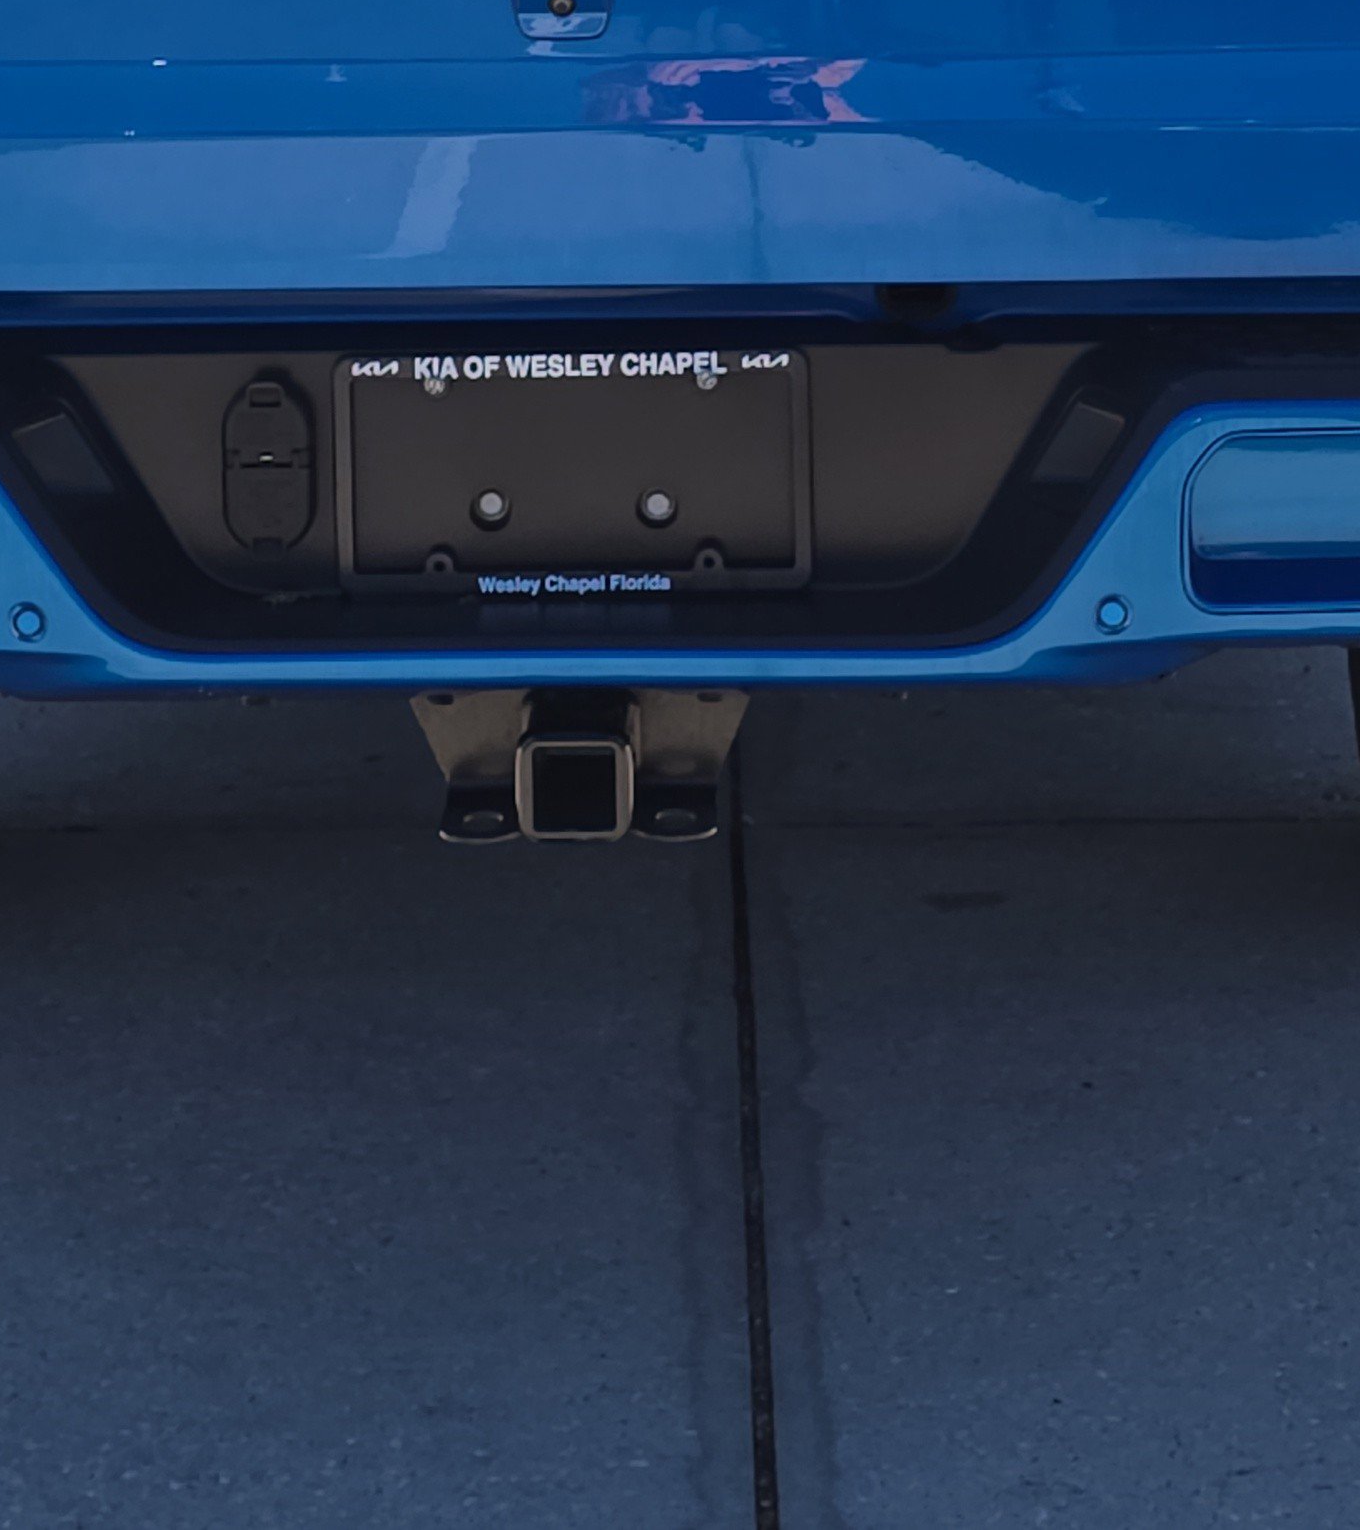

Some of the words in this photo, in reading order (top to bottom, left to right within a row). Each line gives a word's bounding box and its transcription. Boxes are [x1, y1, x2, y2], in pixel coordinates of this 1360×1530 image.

[414, 356, 459, 380] KIA
[463, 355, 501, 380] OF
[505, 353, 615, 379] WESLEY
[620, 351, 727, 377] CHAPEL
[478, 575, 541, 597] Wesley
[544, 573, 606, 595] Chapel
[609, 573, 672, 591] Florida
